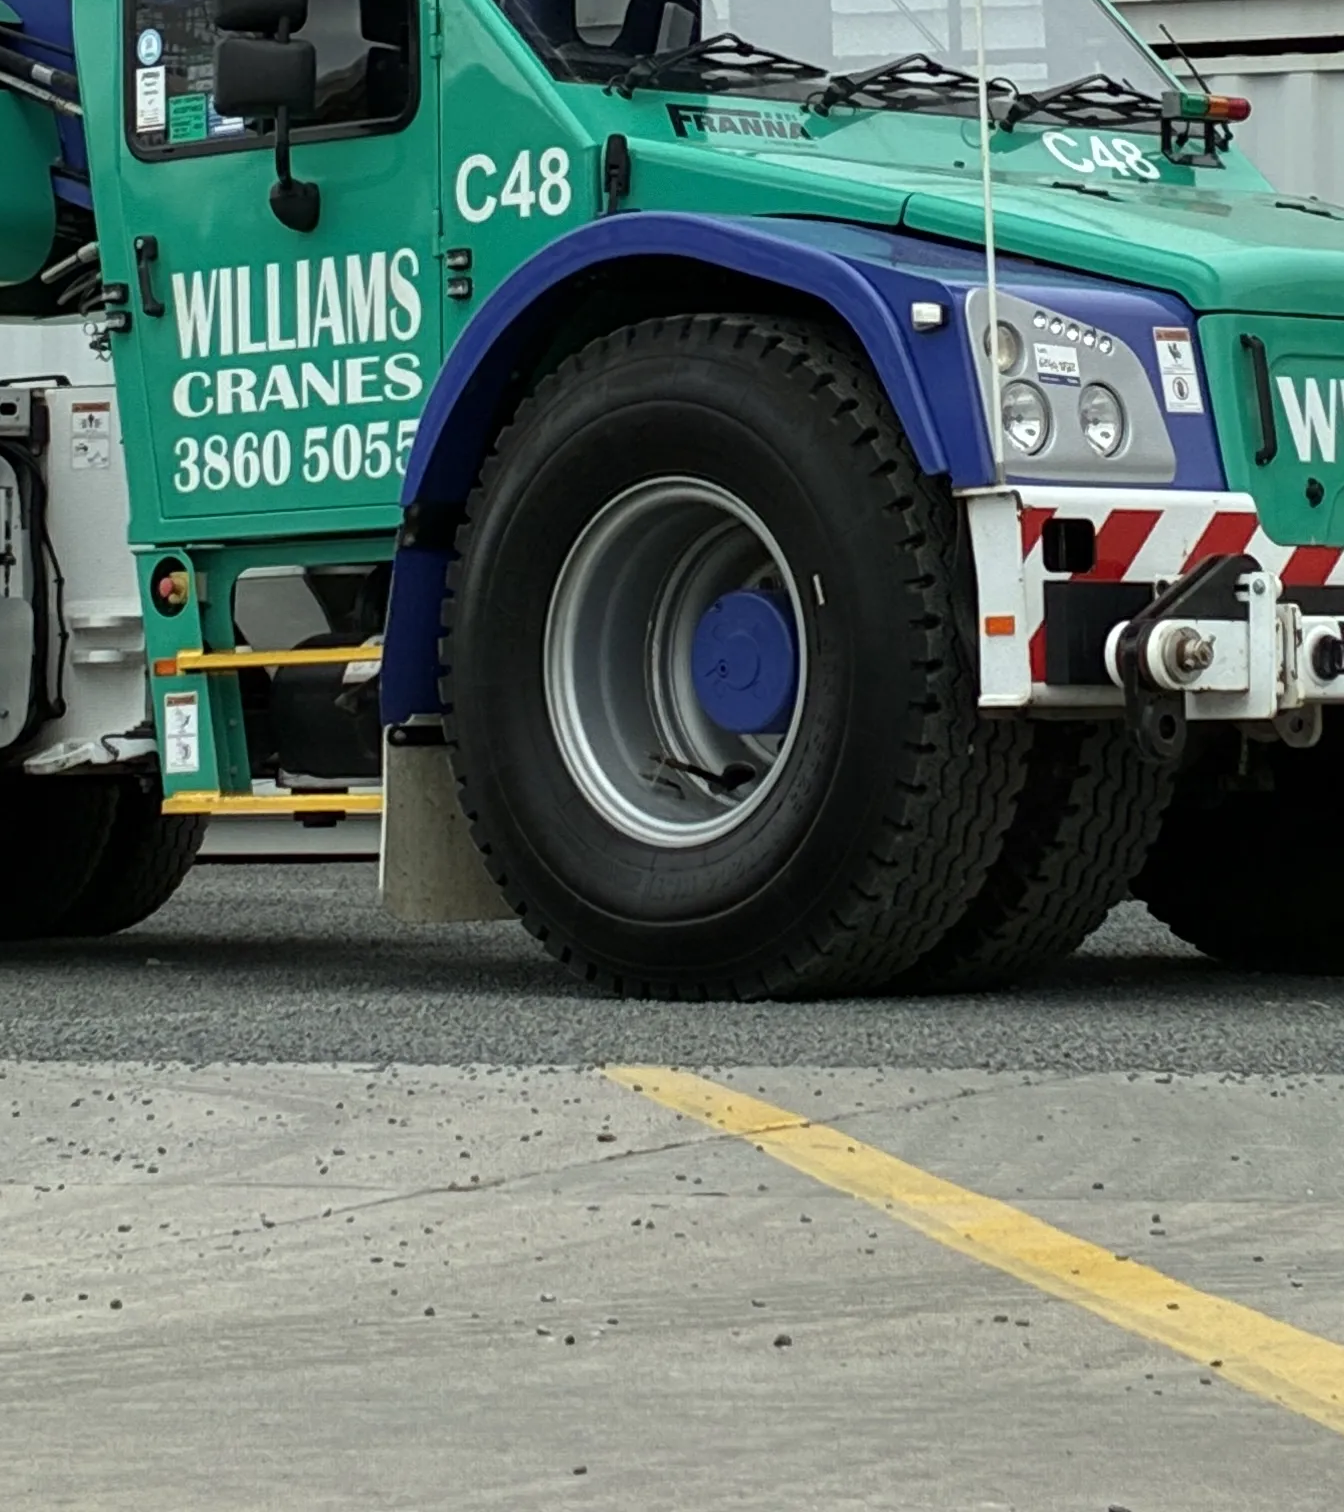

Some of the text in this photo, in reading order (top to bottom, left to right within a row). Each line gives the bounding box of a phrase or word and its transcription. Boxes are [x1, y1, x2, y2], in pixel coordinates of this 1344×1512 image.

[665, 103, 813, 140] FRANNA
[456, 147, 572, 224] C48
[1042, 131, 1161, 180] C48
[172, 247, 422, 360] WILLIAMS
[172, 353, 424, 418] CRANES
[174, 429, 292, 493] 3860
